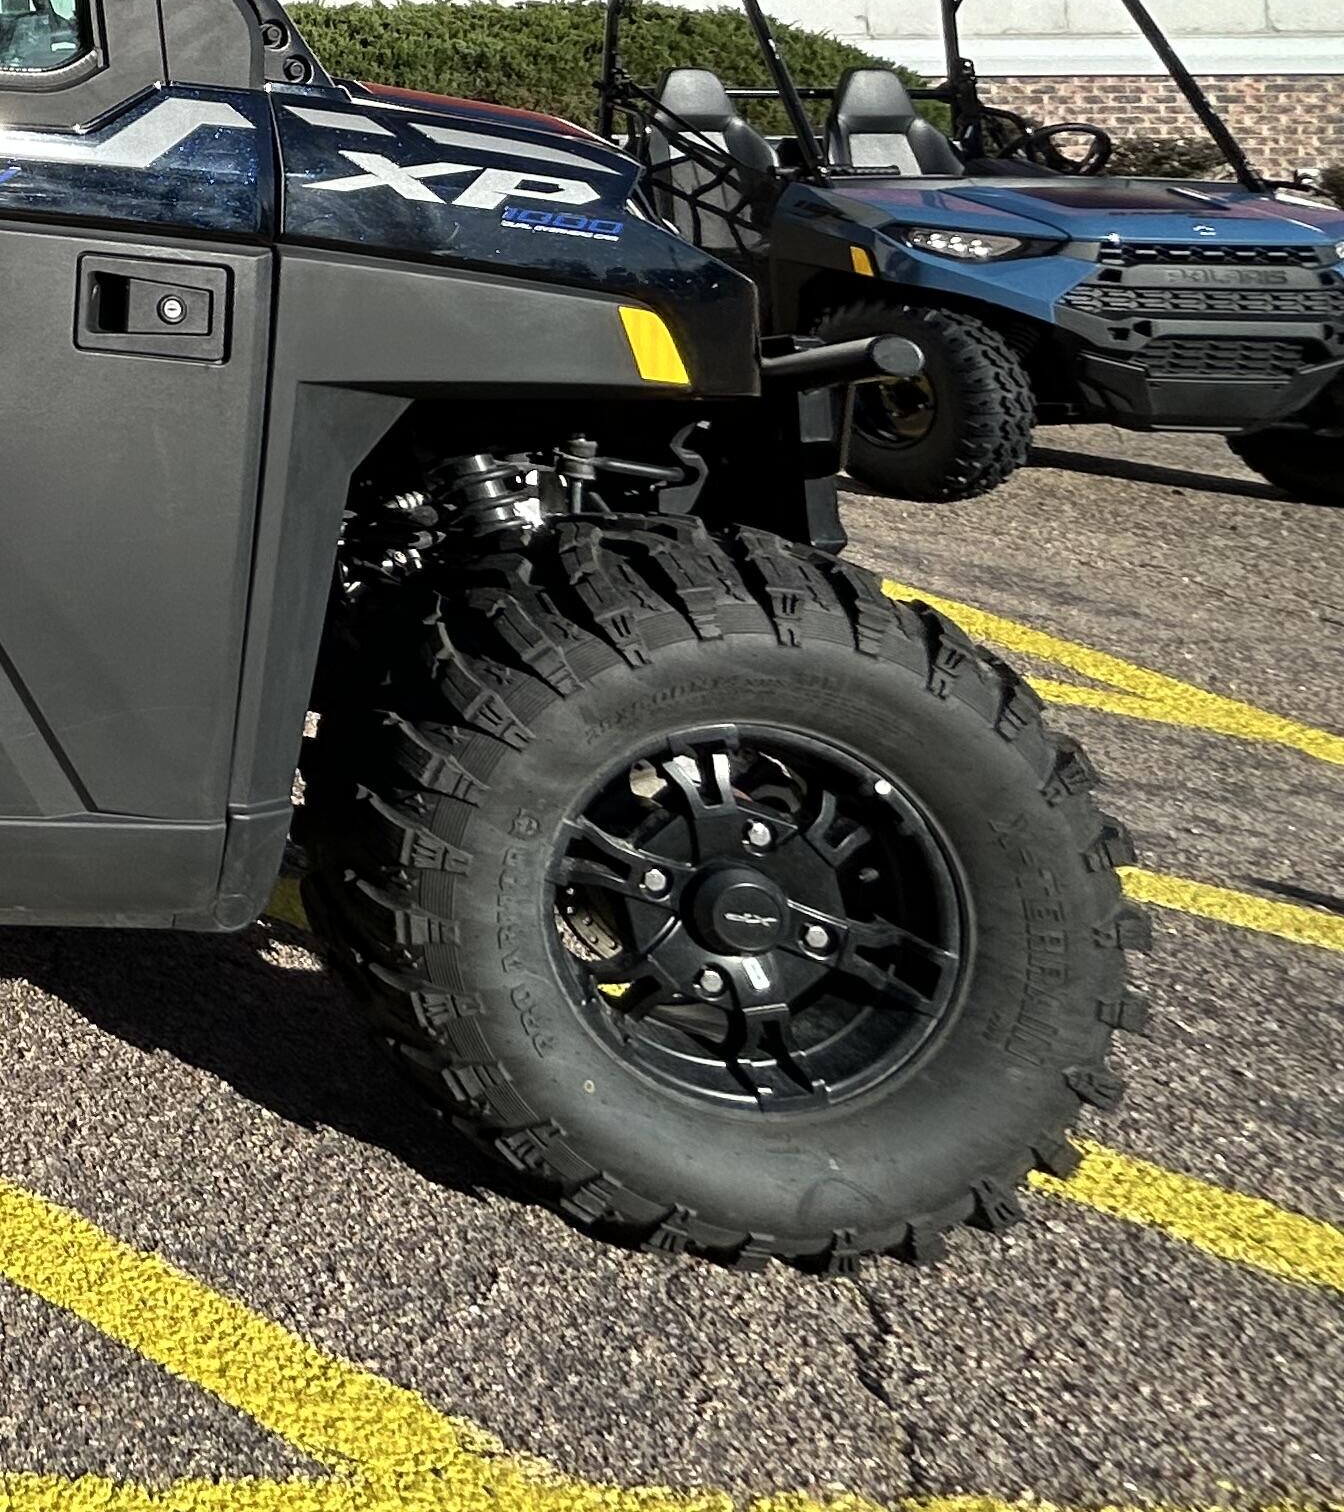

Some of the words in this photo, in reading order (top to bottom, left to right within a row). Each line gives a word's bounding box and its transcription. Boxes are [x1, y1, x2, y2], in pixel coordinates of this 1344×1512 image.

[302, 150, 600, 209] XP
[501, 205, 624, 235] 1000
[1167, 269, 1288, 285] POLARIS
